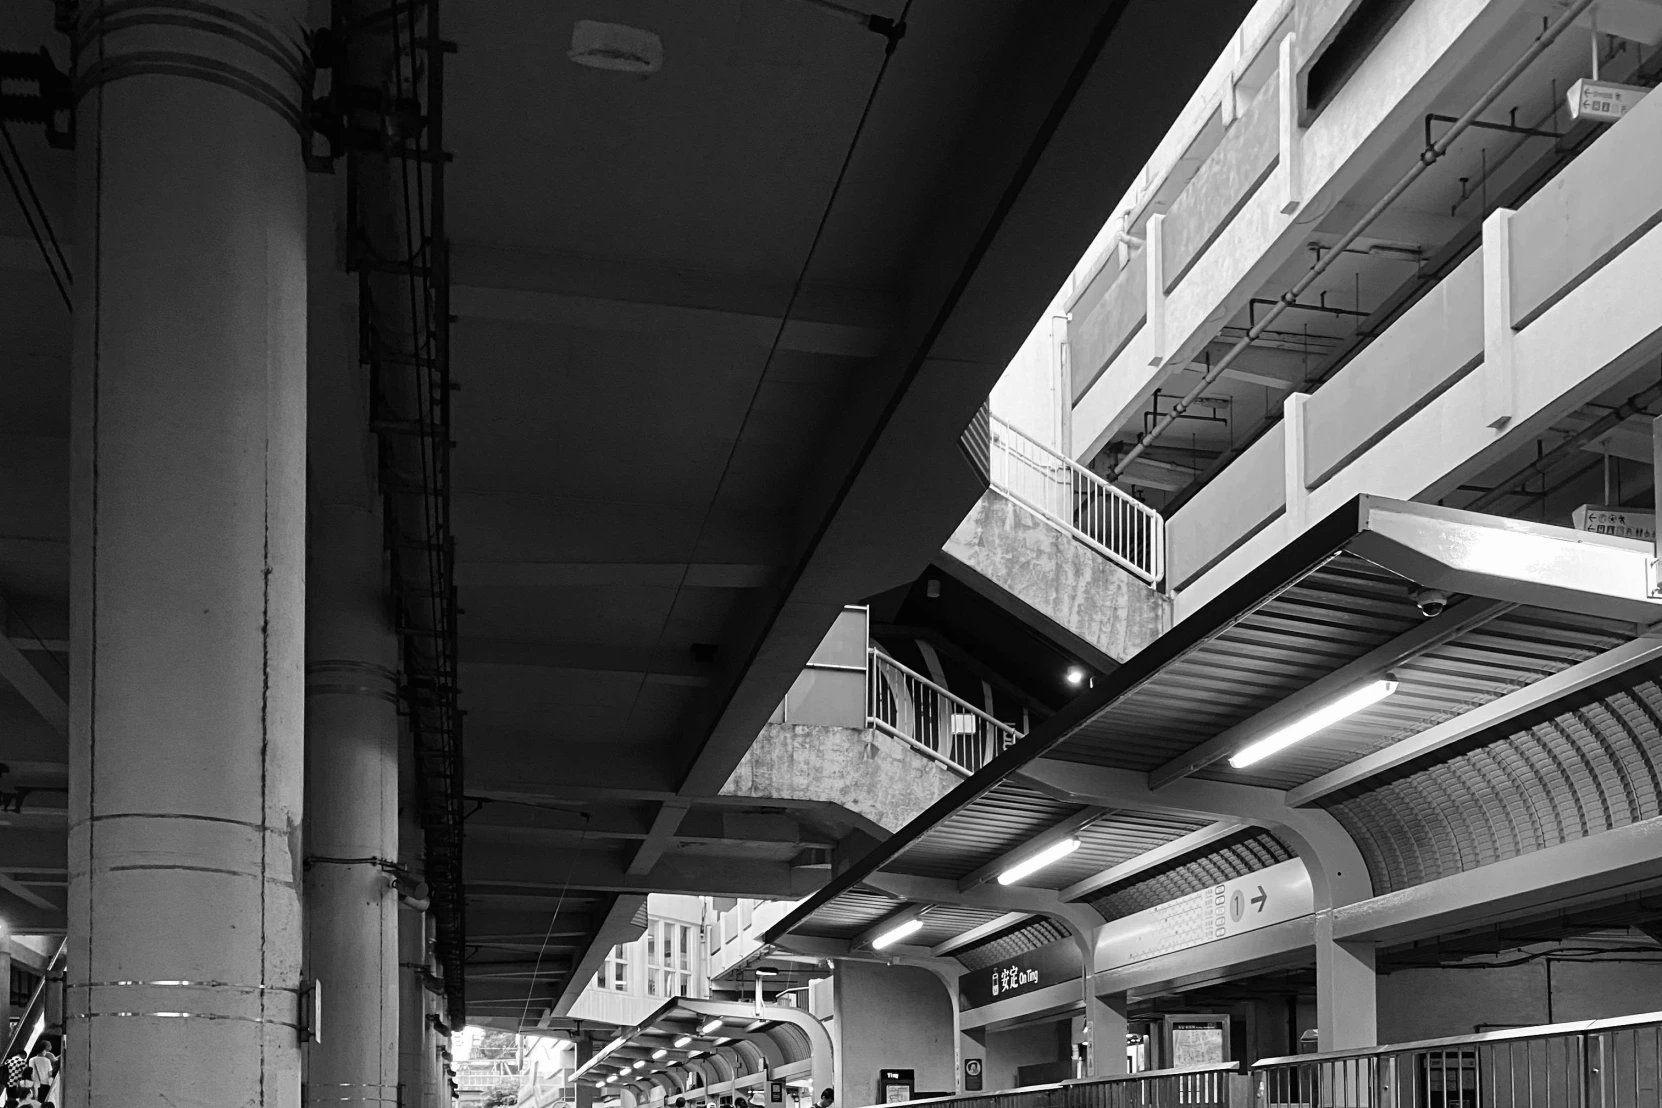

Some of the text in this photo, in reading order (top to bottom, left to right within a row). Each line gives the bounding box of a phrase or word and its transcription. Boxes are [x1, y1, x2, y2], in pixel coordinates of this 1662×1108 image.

[1001, 965, 1019, 992] 安定
[1019, 969, 1038, 985] On Ting
